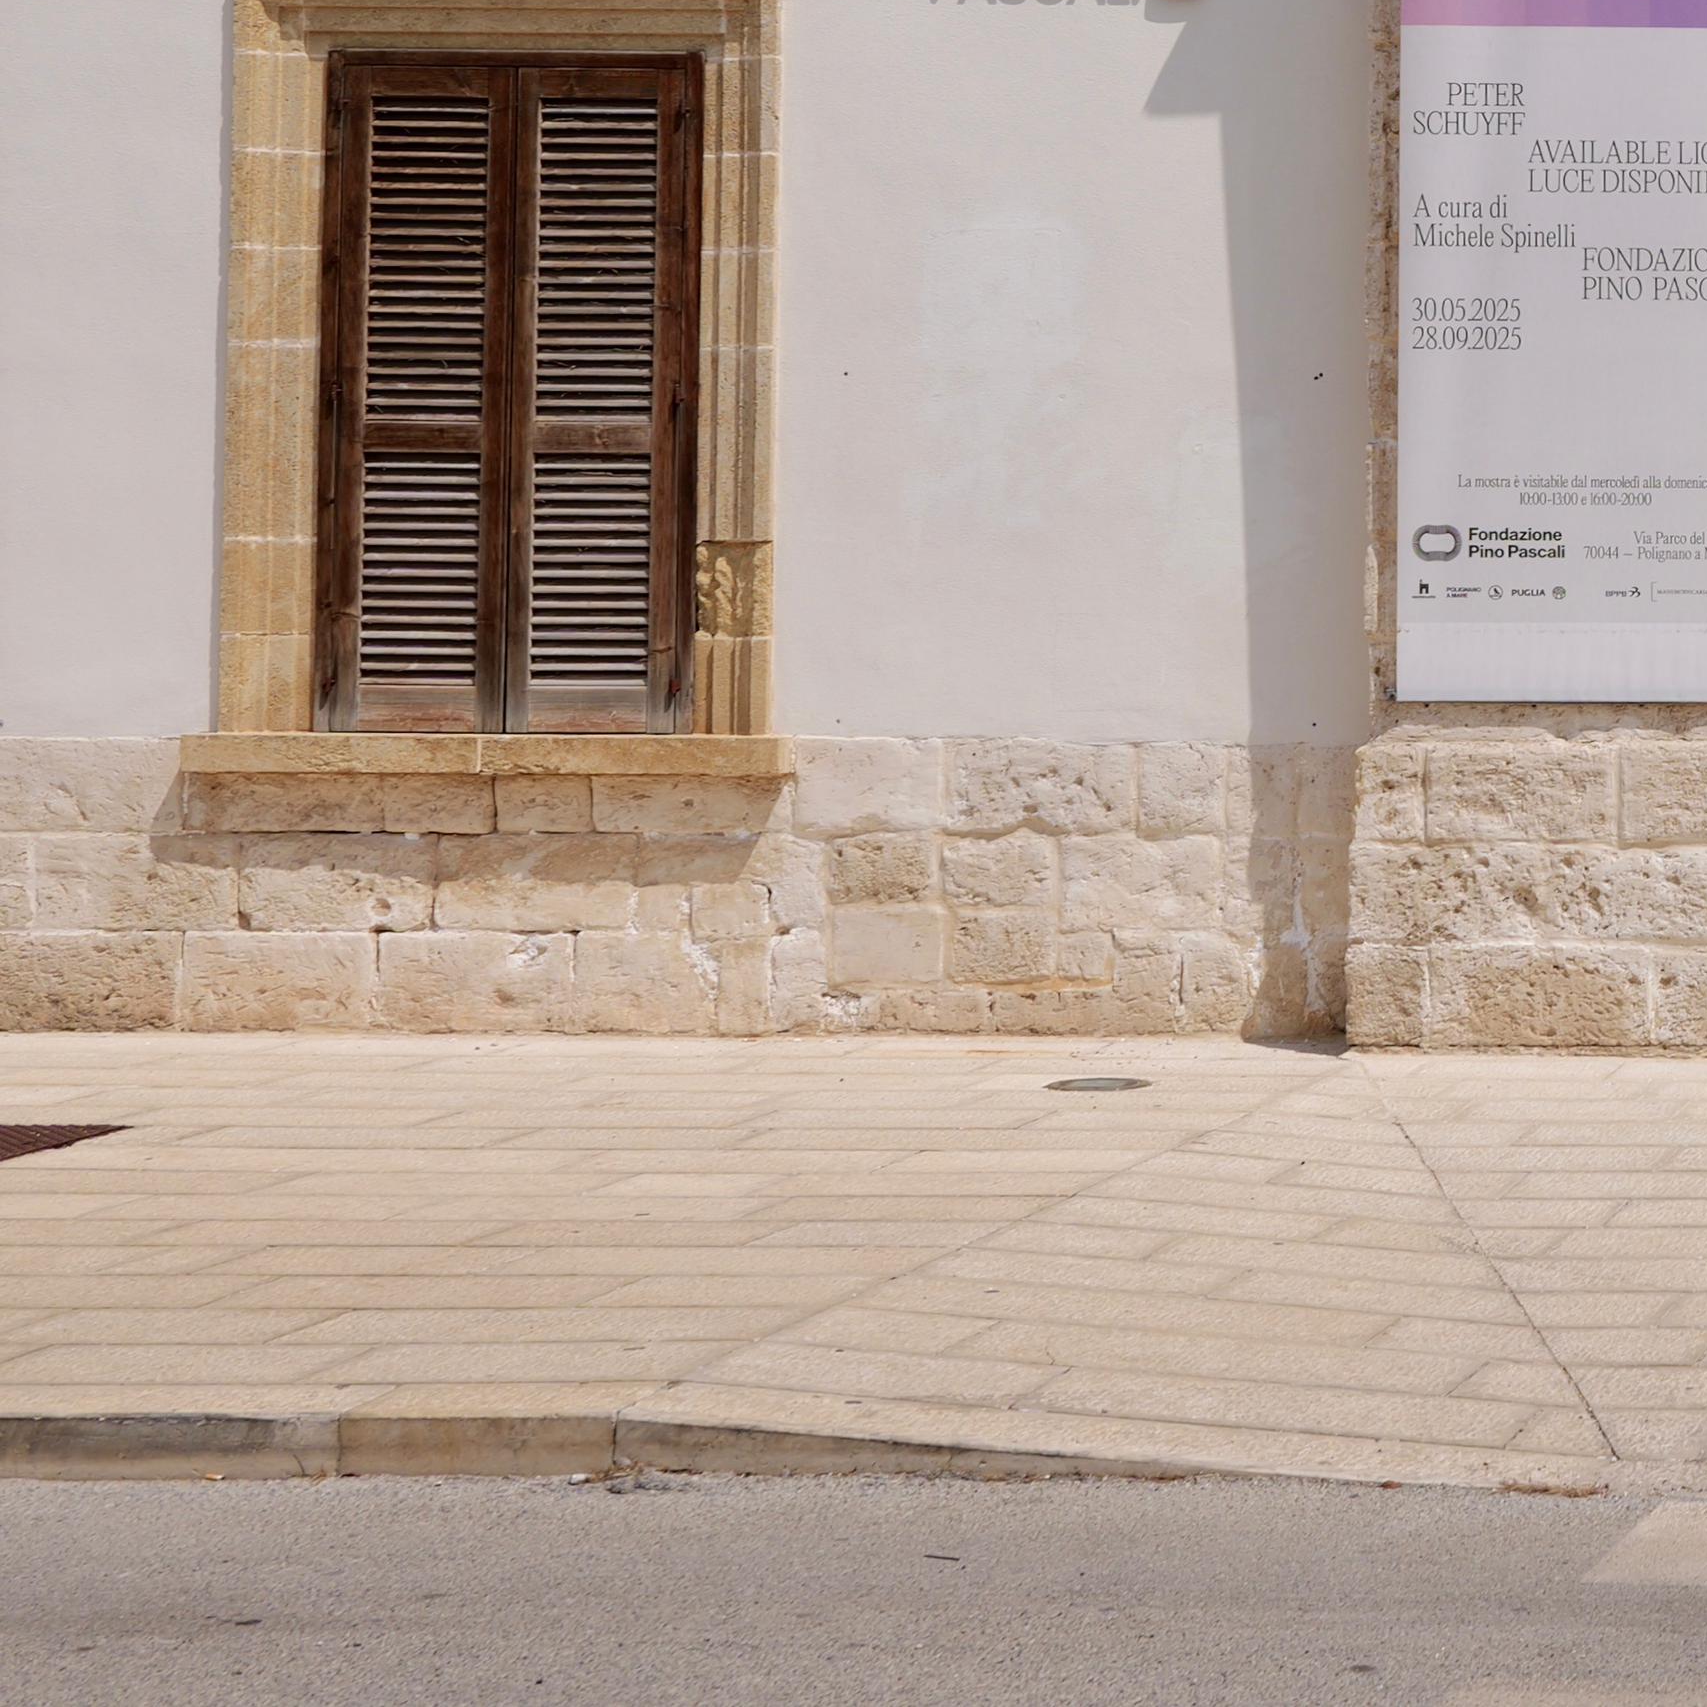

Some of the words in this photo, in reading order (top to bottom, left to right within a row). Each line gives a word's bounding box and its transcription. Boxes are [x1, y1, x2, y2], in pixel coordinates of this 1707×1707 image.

[1447, 82, 1525, 107] PETER
[1413, 111, 1526, 135] SCHUYFF
[1528, 140, 1671, 165] AVAILABLE
[1528, 169, 1595, 193] LUCE
[1413, 194, 1431, 218] A
[1438, 200, 1483, 218] cura
[1489, 194, 1507, 218] di
[1413, 223, 1494, 247] Michele
[1500, 223, 1576, 253] Spinelli
[1581, 276, 1643, 301] PINO
[1412, 297, 1521, 322] 30.05.2025
[1412, 326, 1522, 350] 28.09.2025
[1458, 474, 1472, 488] La
[1475, 476, 1511, 488] mostra
[1523, 474, 1569, 488] visitabile
[1571, 474, 1588, 488] dal
[1590, 475, 1640, 489] mercoledì
[1642, 475, 1662, 489] alla
[1581, 495, 1588, 506] e
[1468, 527, 1563, 541] Fondazione
[1634, 531, 1652, 544] Via
[1656, 531, 1688, 544] Parco
[1690, 532, 1705, 544] del
[1468, 545, 1505, 558] Pino
[1508, 545, 1566, 558] Pascali
[1583, 546, 1619, 559] 70044
[1637, 546, 1692, 562] Polignano
[1694, 550, 1701, 559] a
[1511, 589, 1546, 597] PUGLIA
